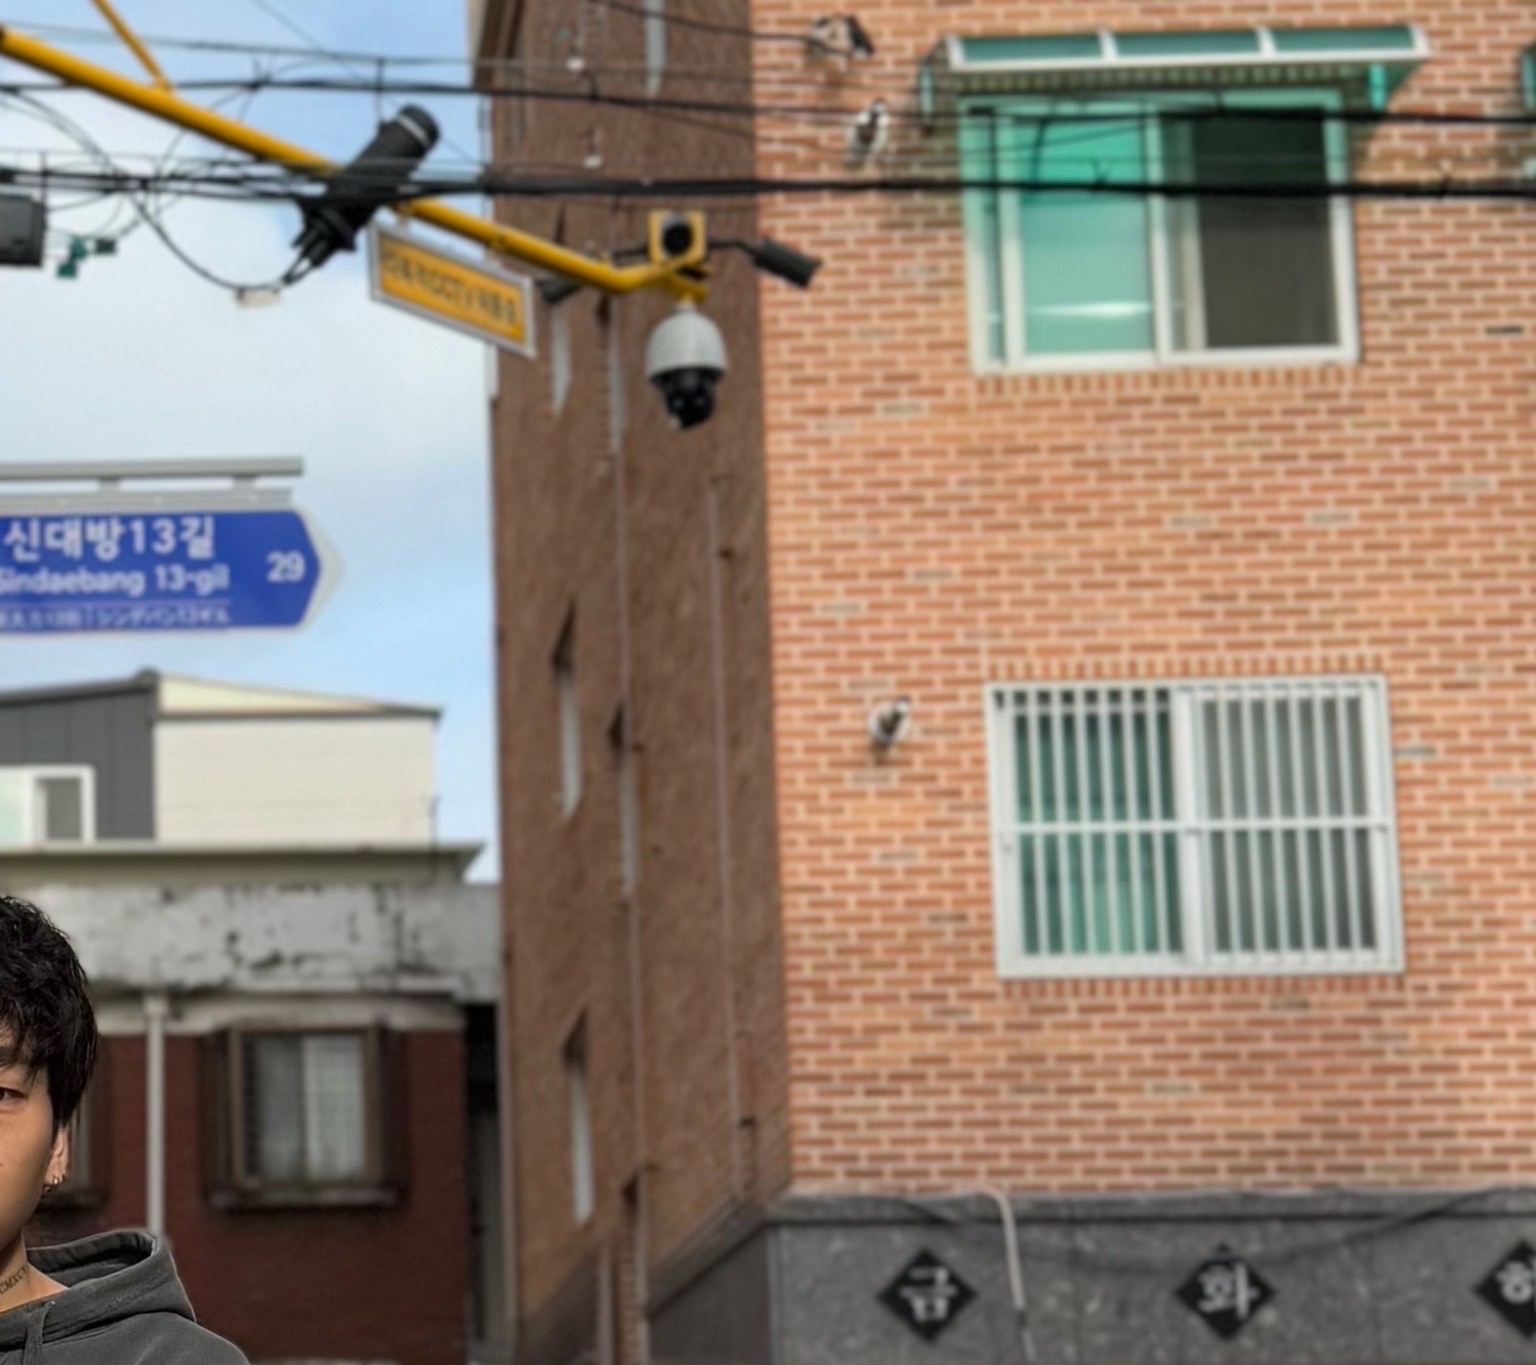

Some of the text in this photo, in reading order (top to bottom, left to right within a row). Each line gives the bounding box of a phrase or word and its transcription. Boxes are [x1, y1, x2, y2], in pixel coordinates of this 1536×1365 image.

[4, 515, 216, 562] 신대방13길
[155, 563, 230, 595] 13-gil
[266, 550, 306, 583] 29
[898, 1261, 1261, 1324] 금 화
